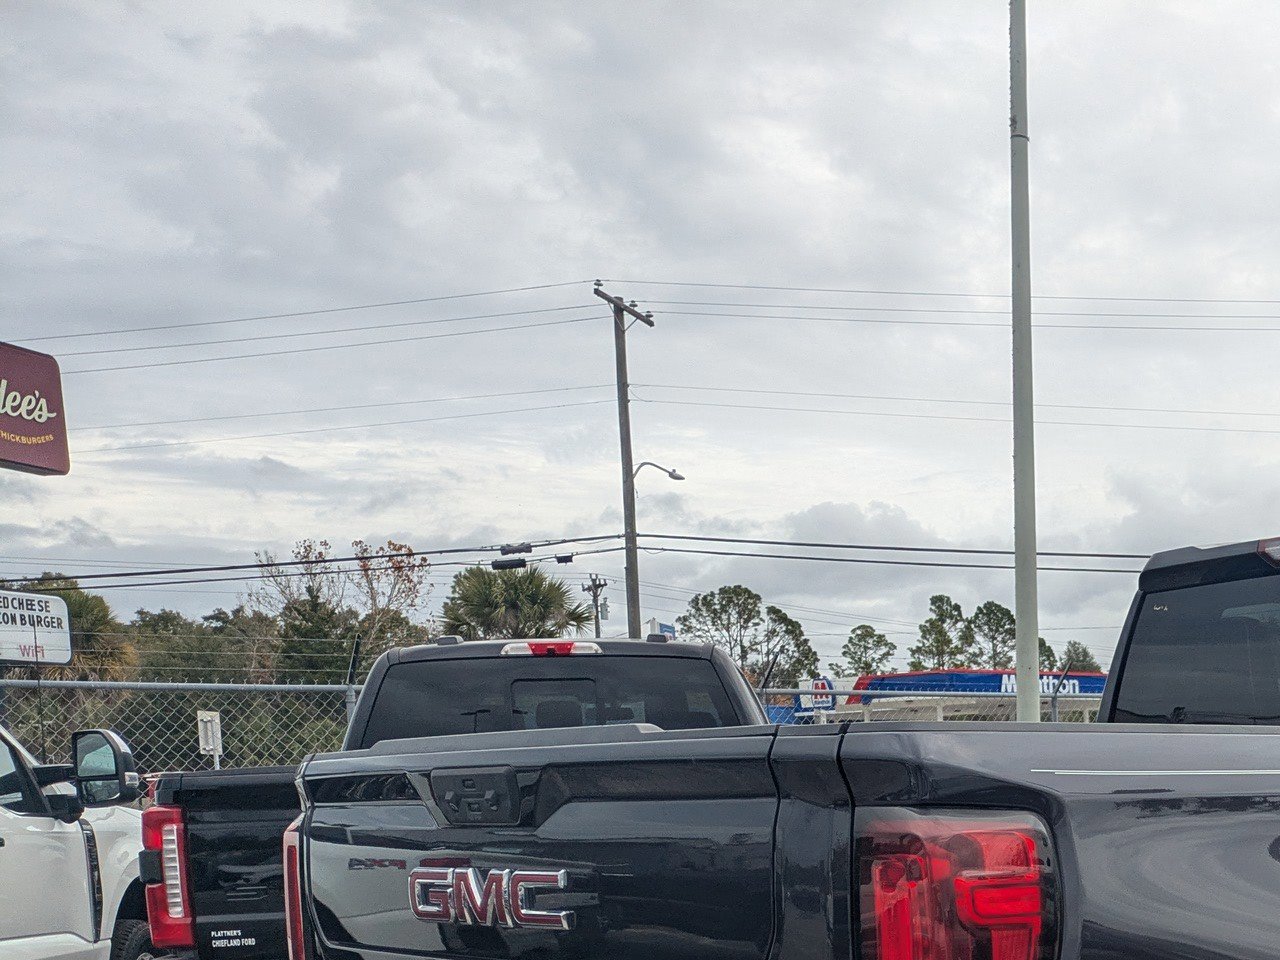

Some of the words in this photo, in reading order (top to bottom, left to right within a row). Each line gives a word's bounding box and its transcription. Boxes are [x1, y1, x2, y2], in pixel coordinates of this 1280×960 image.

[11, 597, 51, 613] CHEESE
[20, 613, 64, 629] BURGER
[19, 644, 45, 658] WiFi
[408, 867, 576, 930] GMC
[211, 929, 242, 938] PLATTNER'S
[211, 939, 241, 948] CHIEFLAND
[241, 938, 256, 946] FORD
